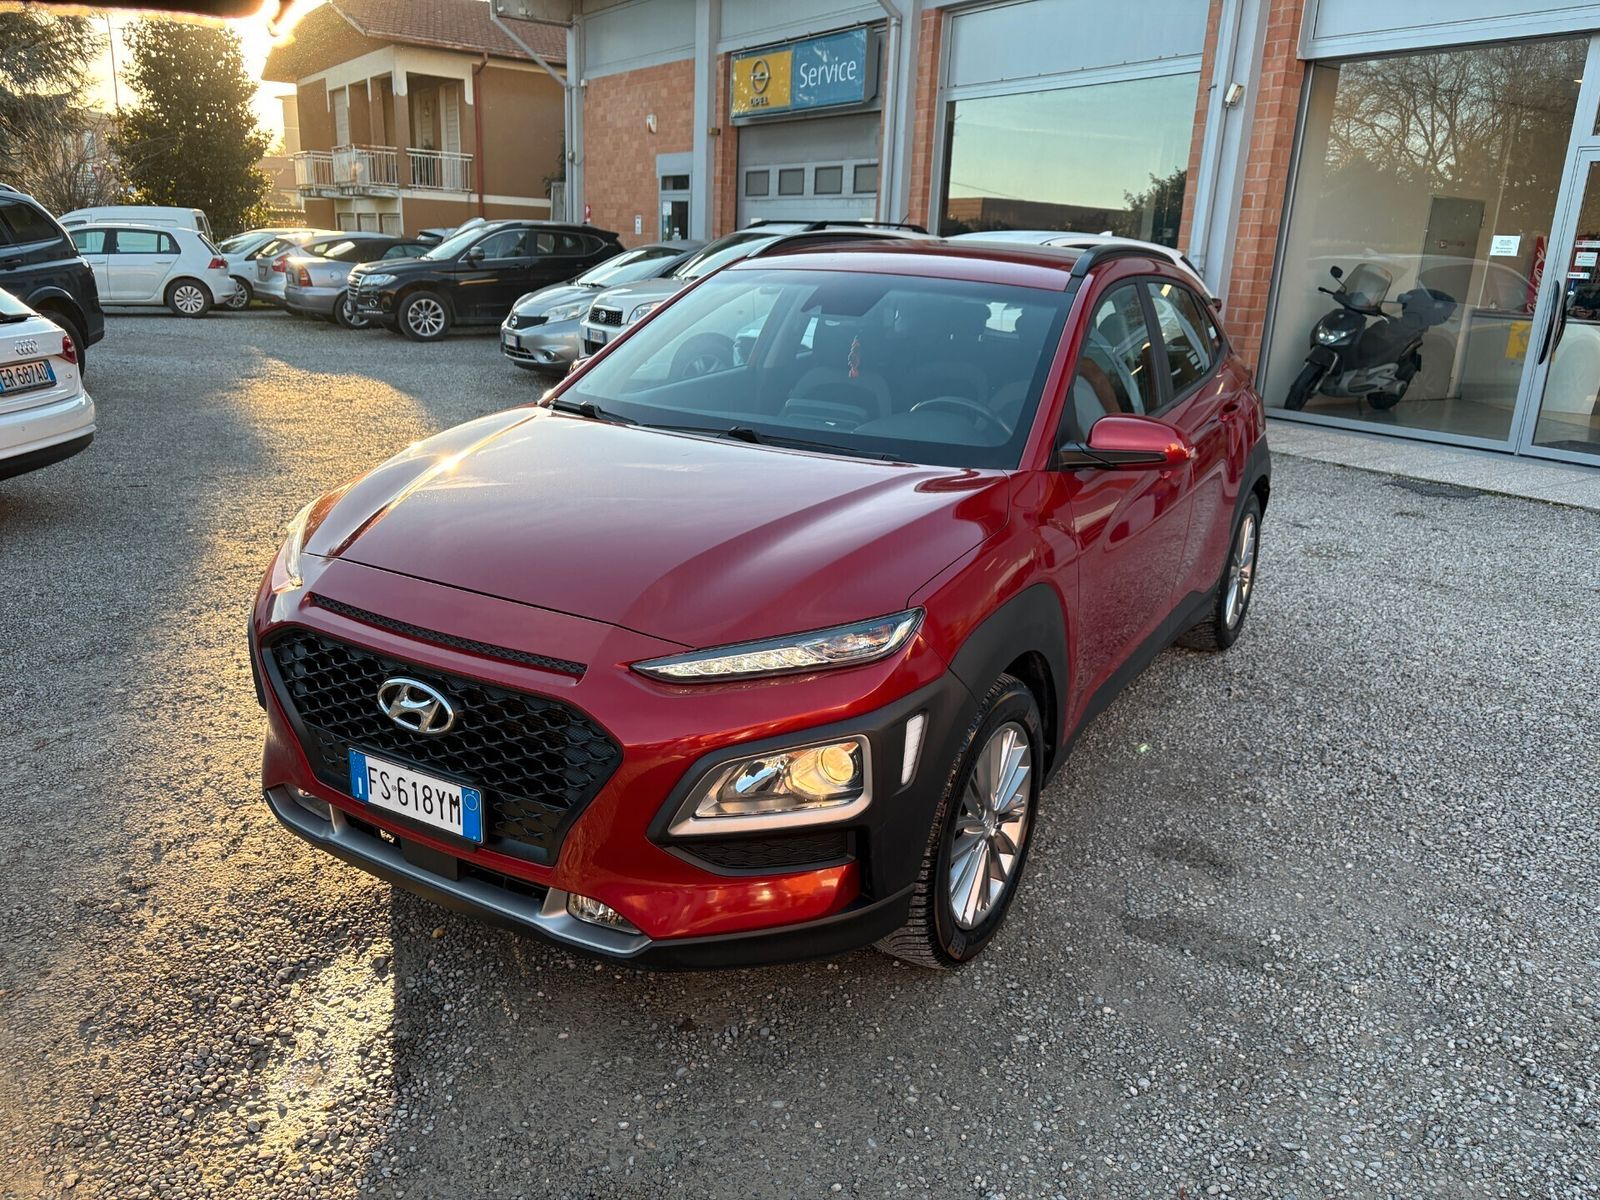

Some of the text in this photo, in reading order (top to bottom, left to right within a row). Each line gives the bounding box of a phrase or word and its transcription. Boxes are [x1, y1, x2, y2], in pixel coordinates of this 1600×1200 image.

[799, 54, 857, 89] Service
[367, 766, 461, 826] FS 618YM
